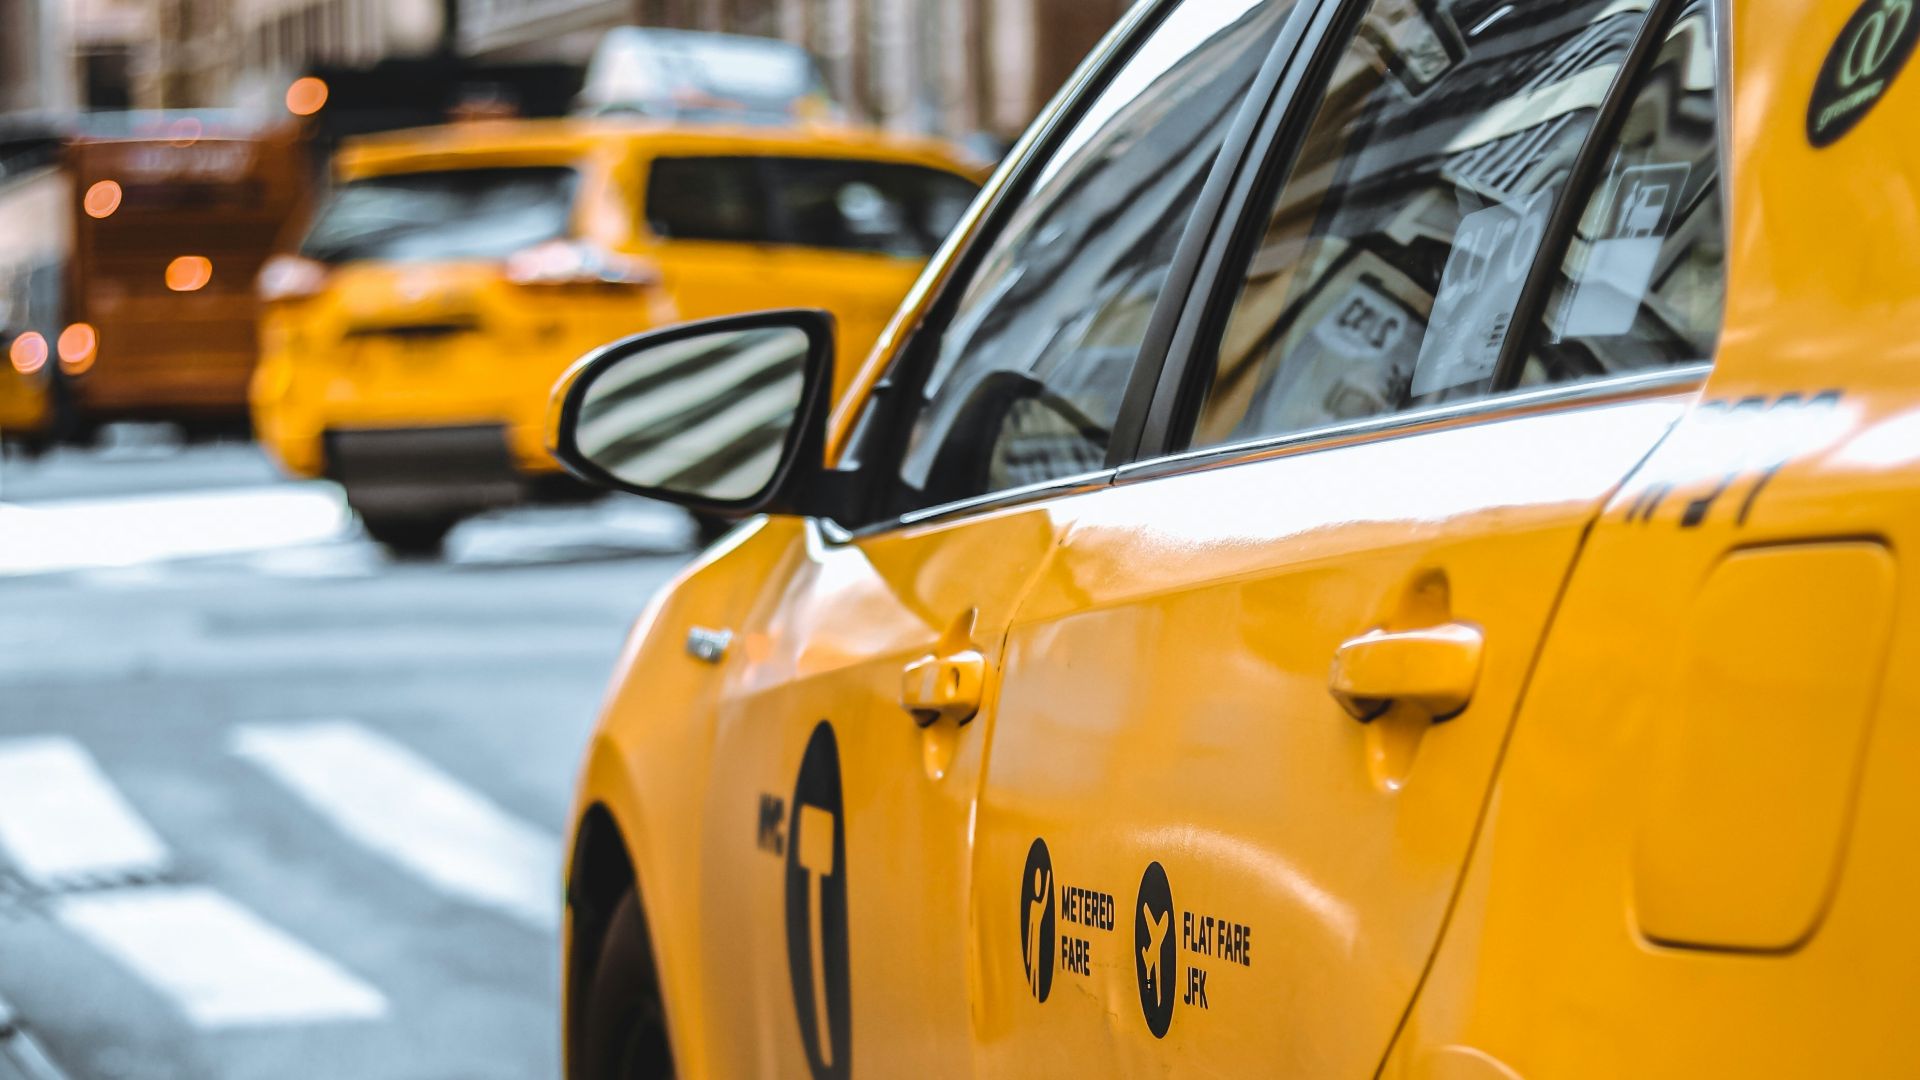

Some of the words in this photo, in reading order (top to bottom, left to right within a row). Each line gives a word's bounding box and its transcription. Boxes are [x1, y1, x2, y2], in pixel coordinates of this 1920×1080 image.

[1061, 884, 1115, 932] METERED
[1061, 935, 1091, 977] FARE
[1183, 911, 1214, 956] FLAT
[1217, 919, 1251, 967] FARE
[1183, 966, 1209, 1010] JFK
